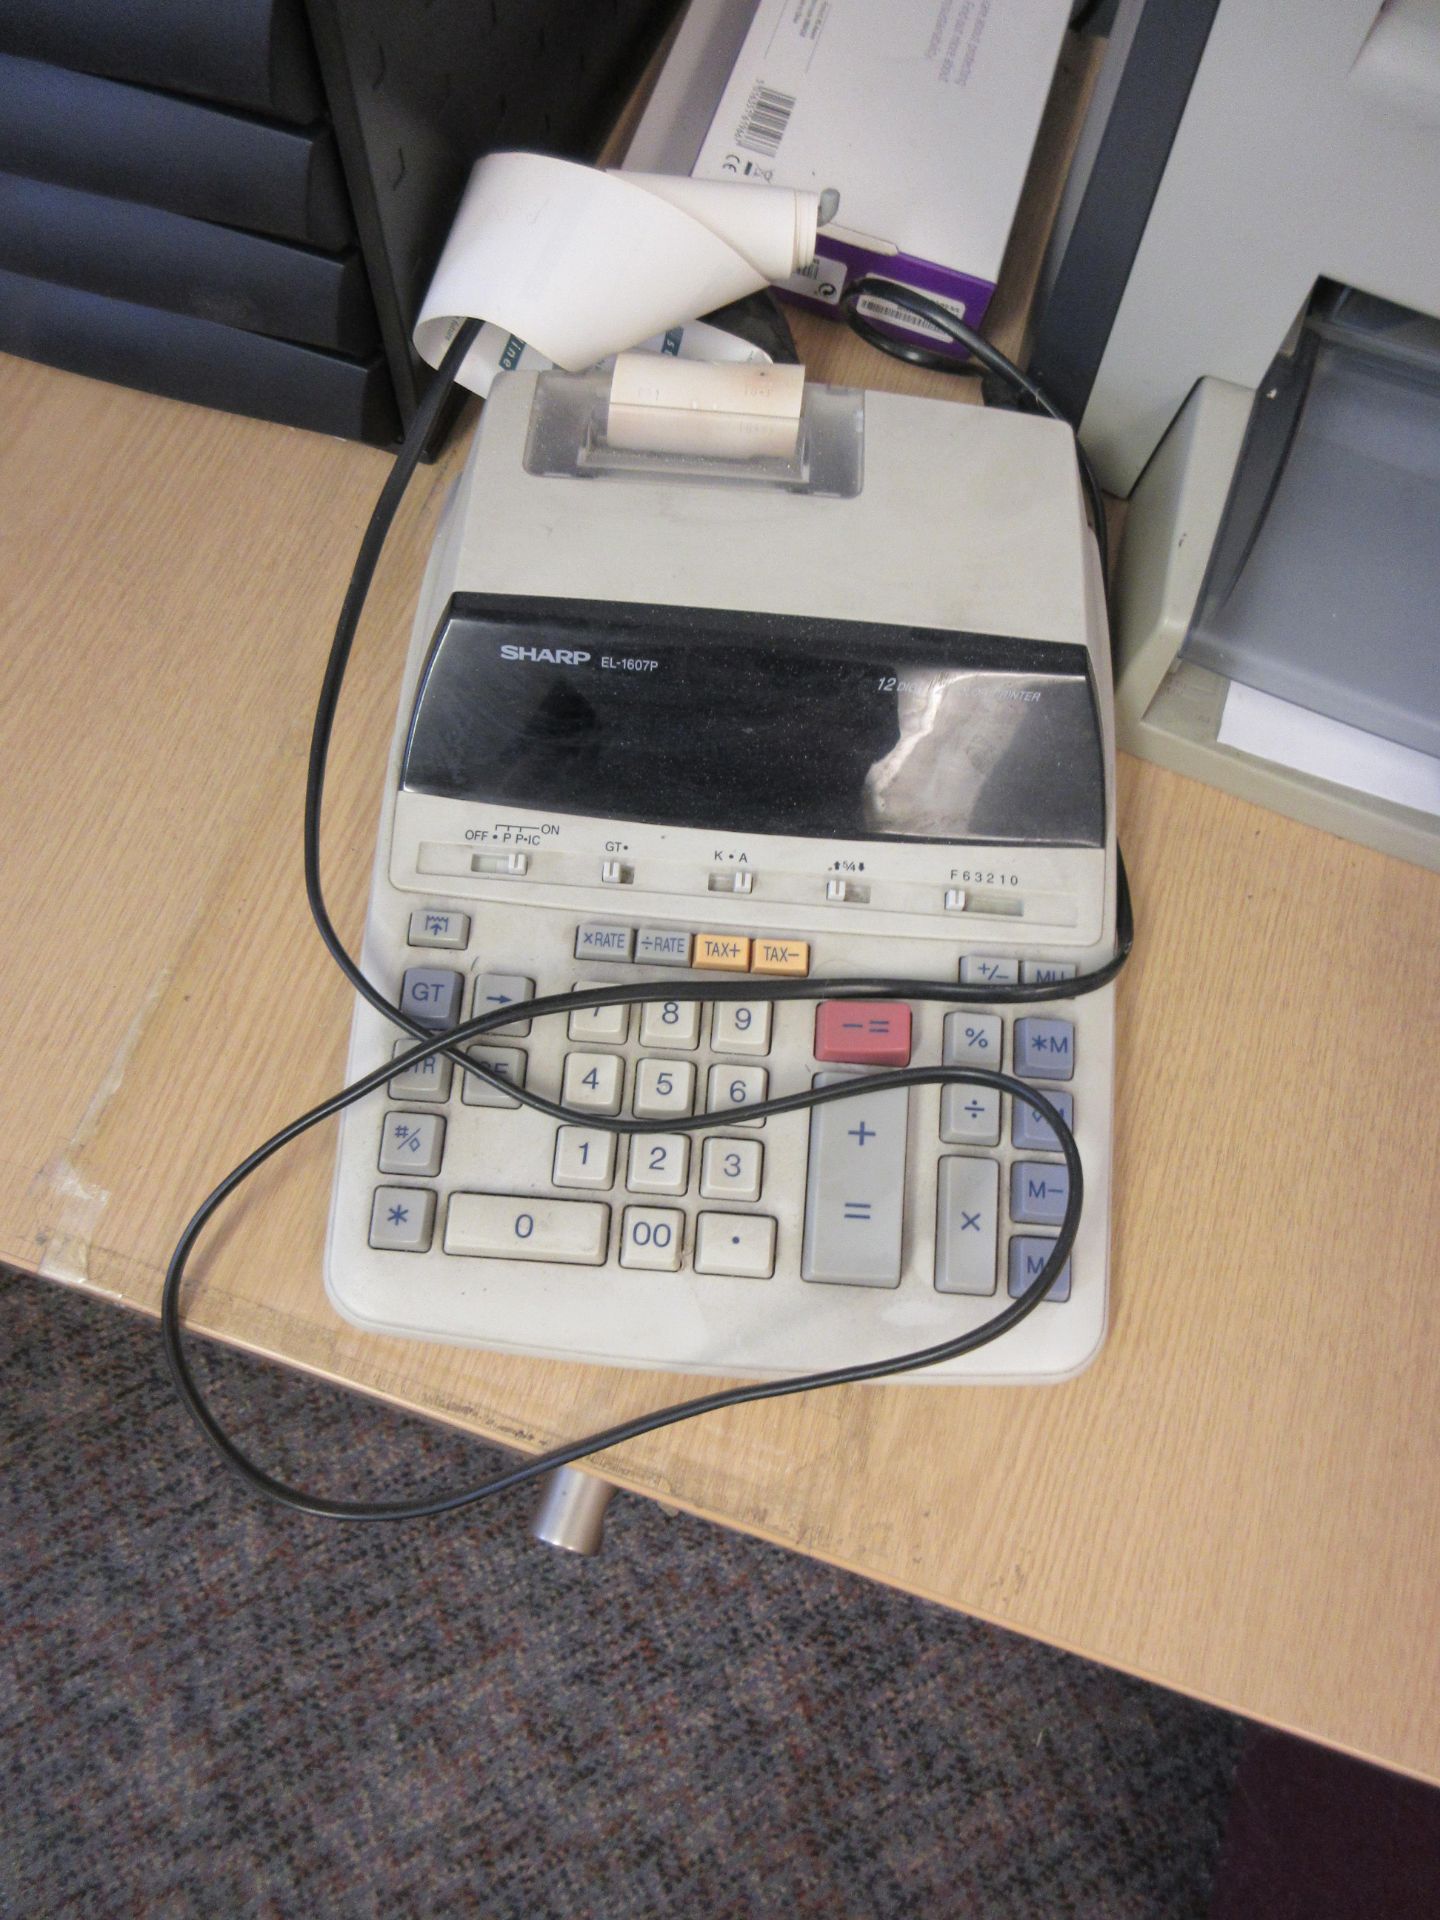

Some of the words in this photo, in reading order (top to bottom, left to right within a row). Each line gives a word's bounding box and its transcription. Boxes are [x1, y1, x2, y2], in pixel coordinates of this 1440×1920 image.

[500, 644, 591, 665] SHARP
[601, 656, 659, 672] EL-1607P
[877, 677, 897, 692] 12
[465, 829, 489, 842] OFF
[503, 832, 512, 843] P
[541, 823, 560, 836] ON
[714, 850, 723, 862] K
[738, 852, 748, 864] A
[411, 983, 445, 1002] GT
[661, 1001, 679, 1025] 8
[734, 1007, 752, 1031] 9
[964, 1027, 989, 1049] %
[581, 1067, 600, 1091] 4
[655, 1072, 674, 1096] 5
[729, 1079, 748, 1103] 6
[578, 1141, 590, 1166] 1
[648, 1146, 668, 1171] 2
[723, 1153, 742, 1178] 3
[514, 1213, 535, 1239] 0
[631, 1220, 672, 1248] 00
